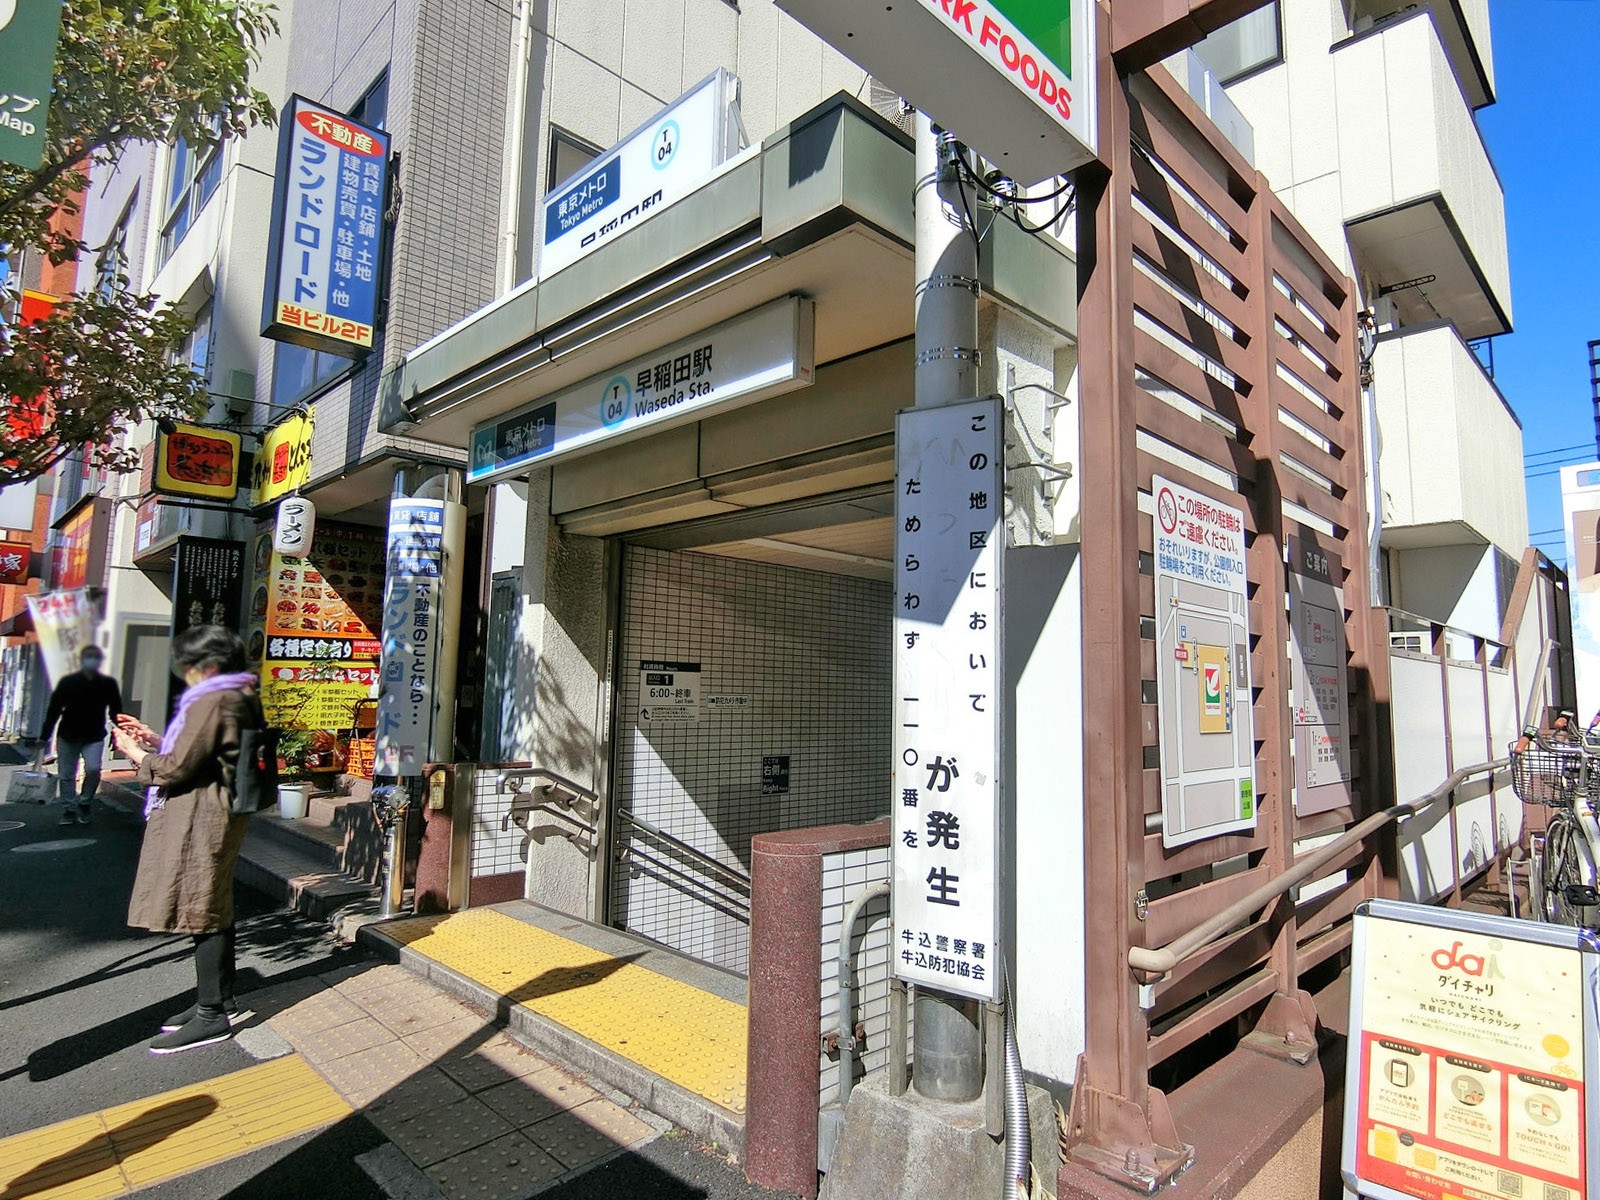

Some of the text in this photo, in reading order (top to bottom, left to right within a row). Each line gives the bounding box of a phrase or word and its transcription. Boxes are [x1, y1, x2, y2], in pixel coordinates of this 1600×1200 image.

[980, 16, 1072, 120] FOODS
[0, 94, 40, 113] プ
[311, 113, 373, 155] 不動産
[662, 128, 669, 141] T
[658, 144, 673, 161] 04
[558, 172, 607, 219] 東京メトロ
[294, 136, 327, 303] ランドロード
[355, 162, 380, 282] 賃貸・店舗・土地
[560, 196, 604, 230] Tokyo Metro
[281, 304, 369, 340] 当ビル2F
[635, 344, 713, 397] 早稲田駅
[613, 386, 620, 398] T
[635, 378, 715, 418] Waseda Sta.
[607, 404, 623, 418] 04
[505, 417, 545, 444] 東京メトロ
[506, 436, 542, 458] Tokyo Metro
[281, 504, 305, 545] ラーメン
[1178, 494, 1241, 533] この場所の駐輪は
[969, 415, 988, 712] この地区において
[1306, 551, 1328, 576] ご案内
[664, 675, 669, 685] 1
[926, 755, 960, 907] が発生
[901, 929, 986, 960] 牛込警察署
[901, 949, 986, 981] 牛込防犯協会
[1438, 975, 1495, 997] ダイチャリ
[1431, 997, 1504, 1018] いつでも どこでも
[1515, 1131, 1546, 1146] TOUCH
